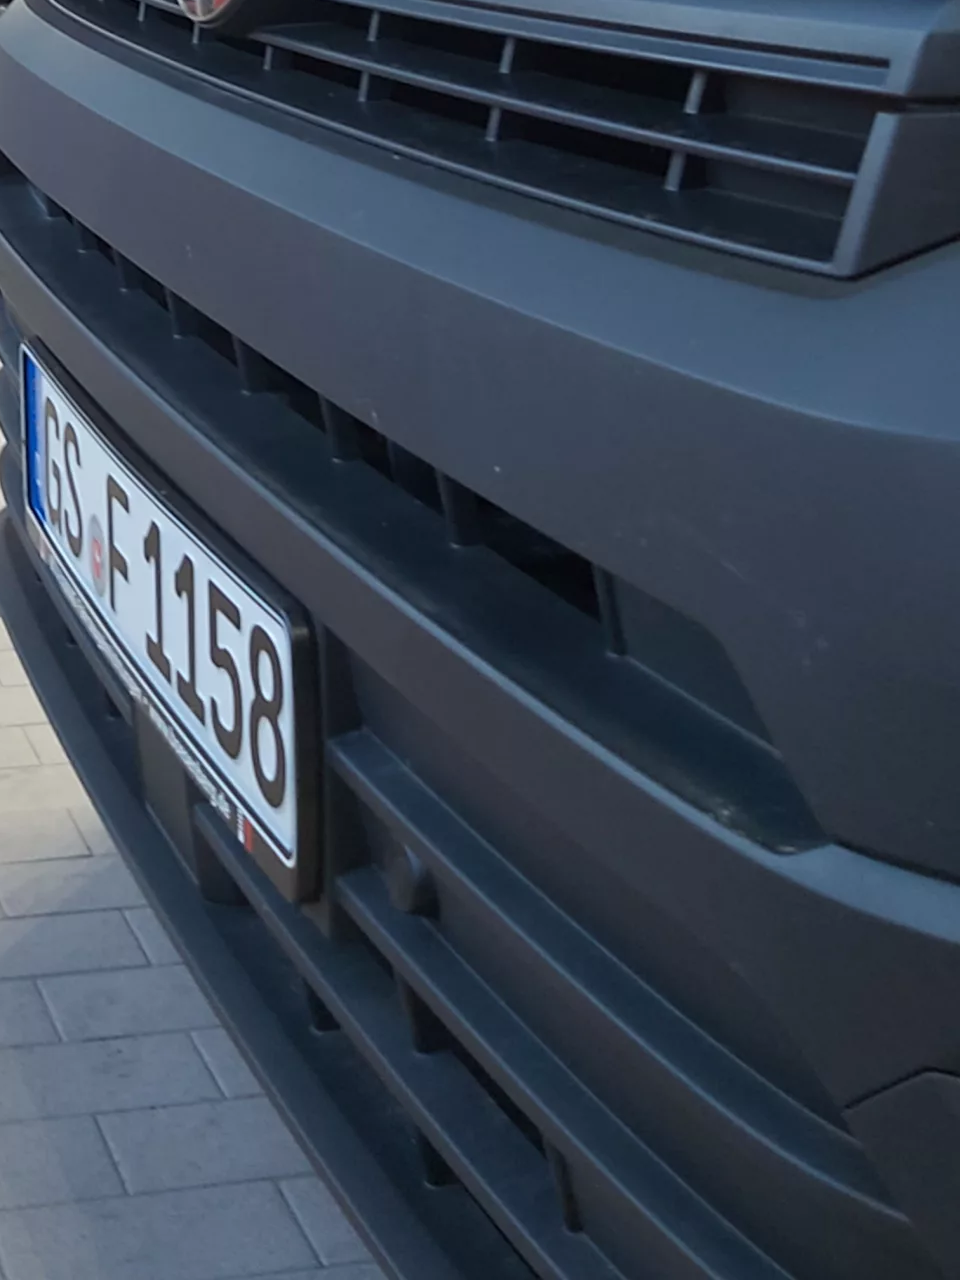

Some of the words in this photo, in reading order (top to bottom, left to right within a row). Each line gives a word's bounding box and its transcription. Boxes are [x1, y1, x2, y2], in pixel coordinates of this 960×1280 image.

[44, 396, 82, 558] GS
[107, 474, 129, 613] F
[144, 520, 286, 807] 1158
